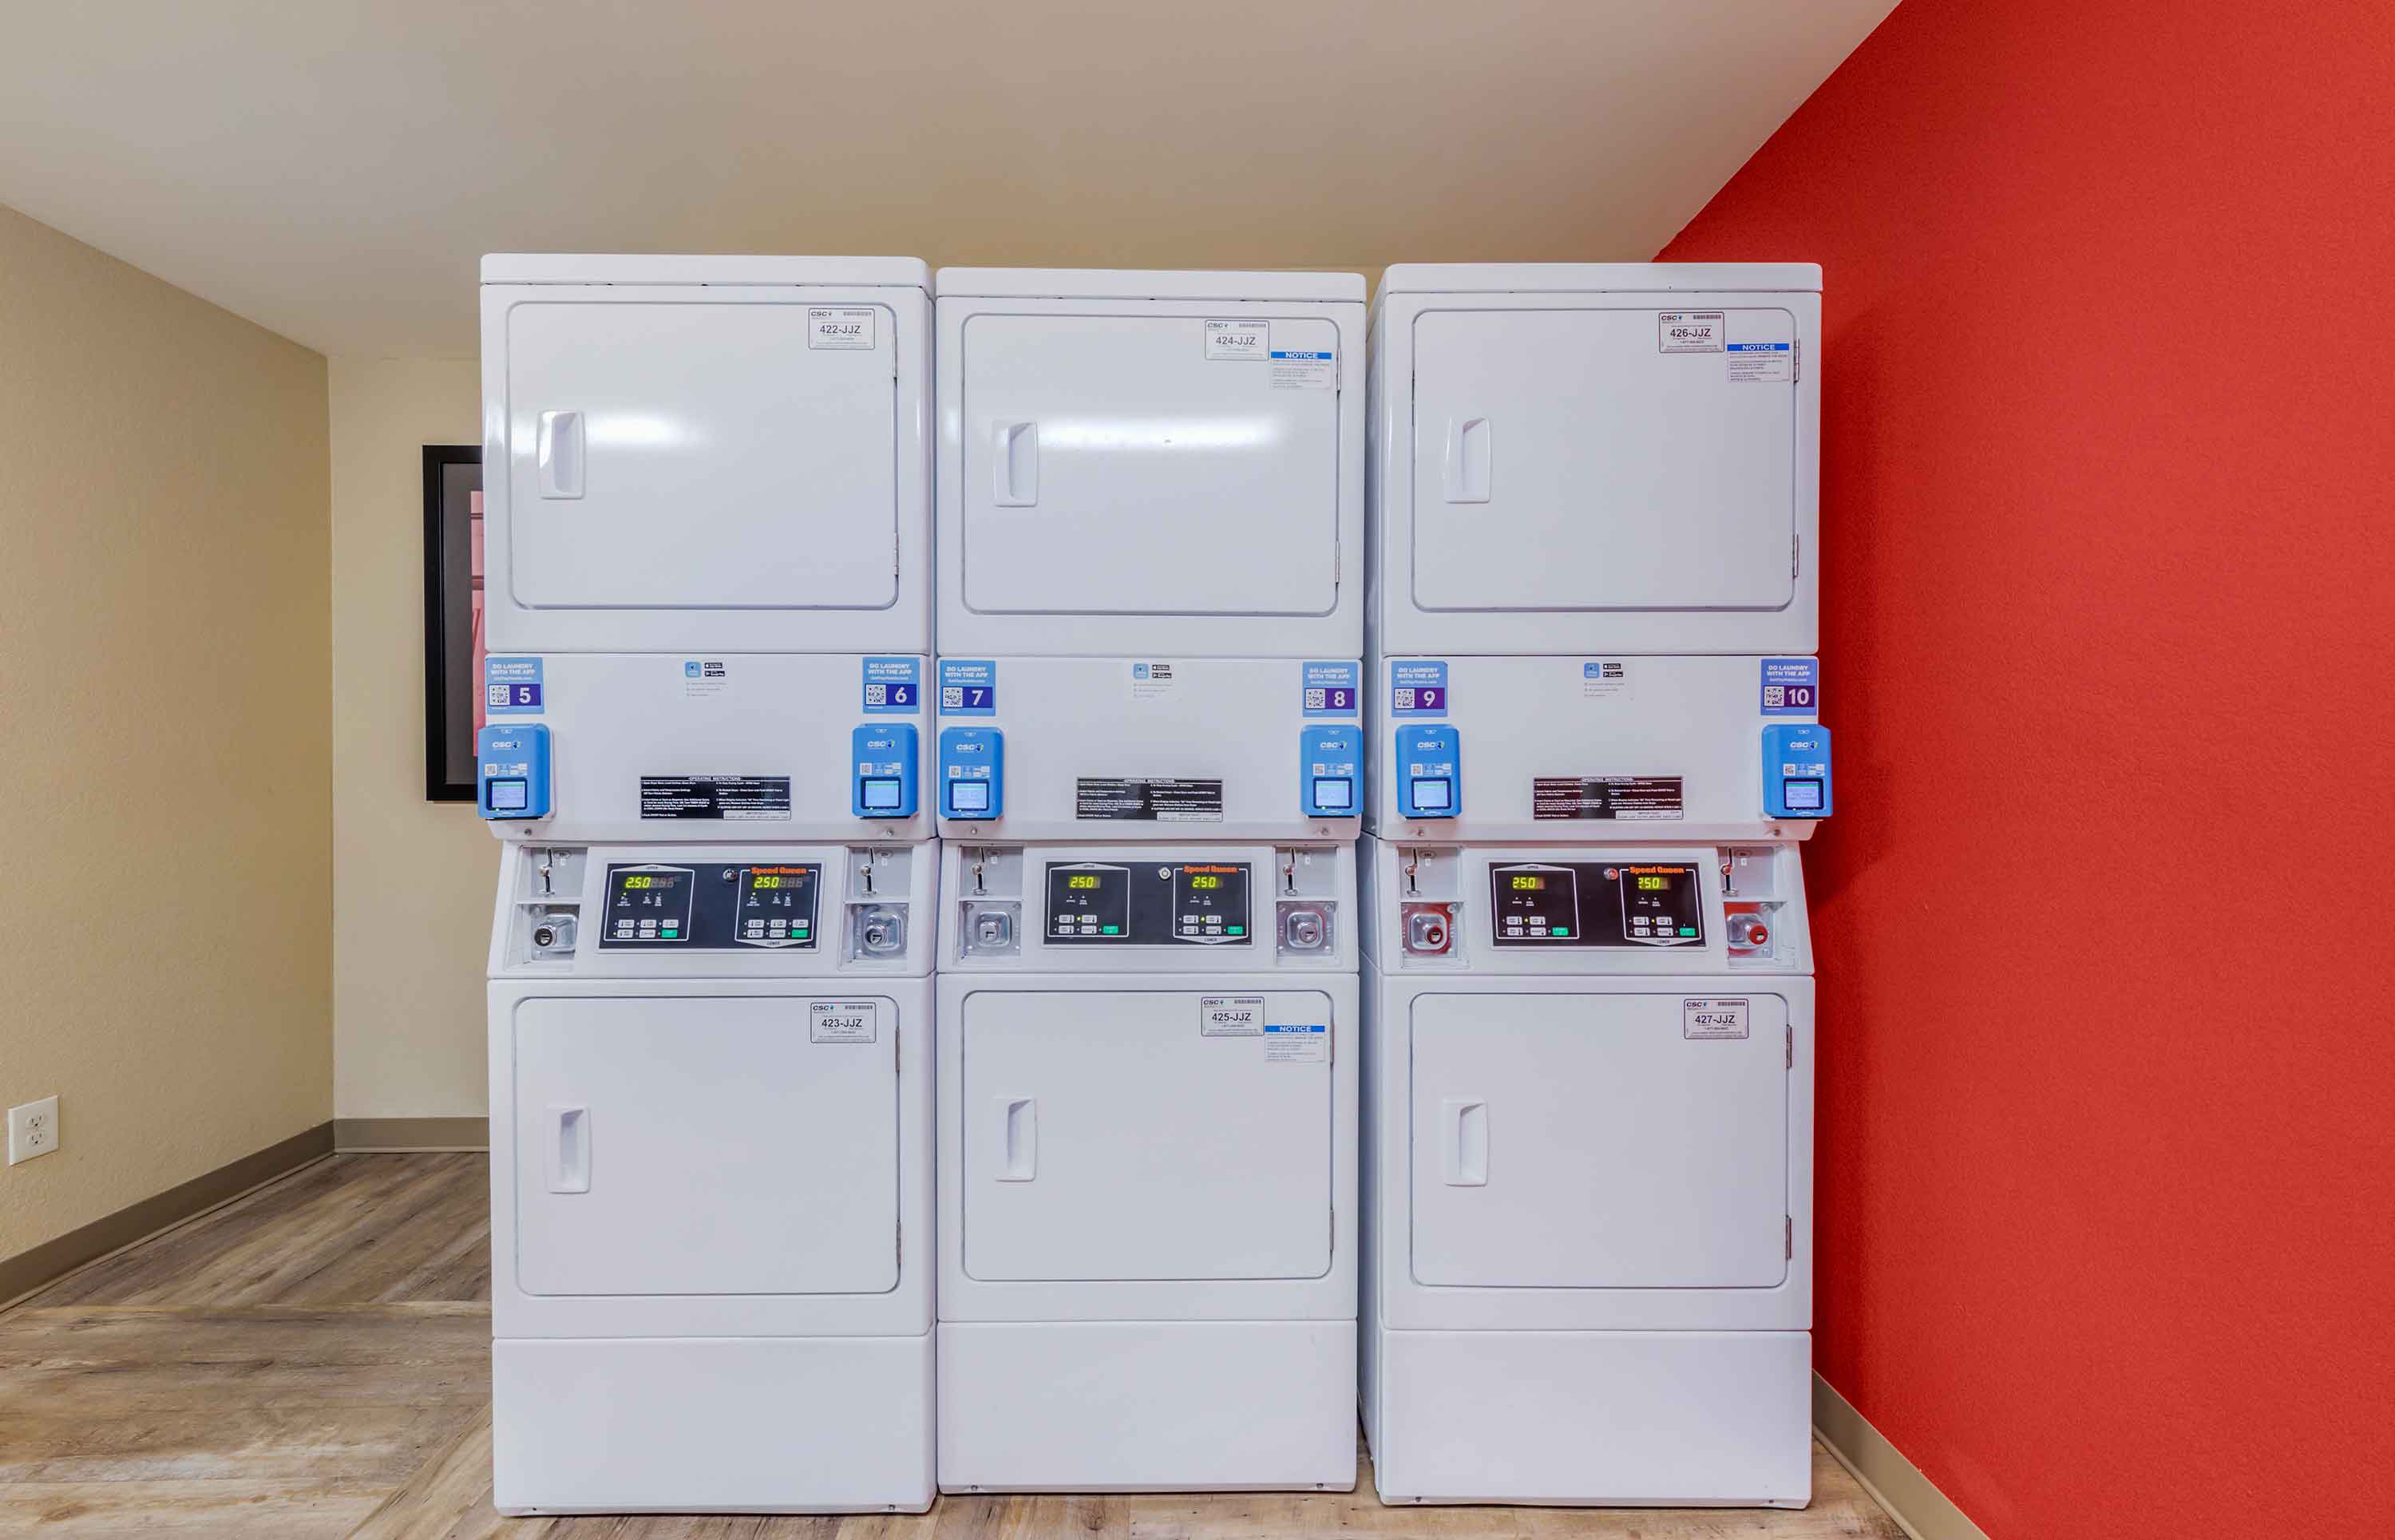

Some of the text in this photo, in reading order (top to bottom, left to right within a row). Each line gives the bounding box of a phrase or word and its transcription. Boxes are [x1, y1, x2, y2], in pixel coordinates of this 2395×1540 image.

[1216, 336, 1256, 345] 424-JJZ
[519, 687, 531, 703] 5
[895, 687, 907, 703] 6
[972, 690, 984, 706] 7
[1334, 691, 1345, 707] 8
[1423, 691, 1435, 707] 9
[1788, 688, 1809, 705] 10
[1212, 1012, 1251, 1021] 425-JJZ
